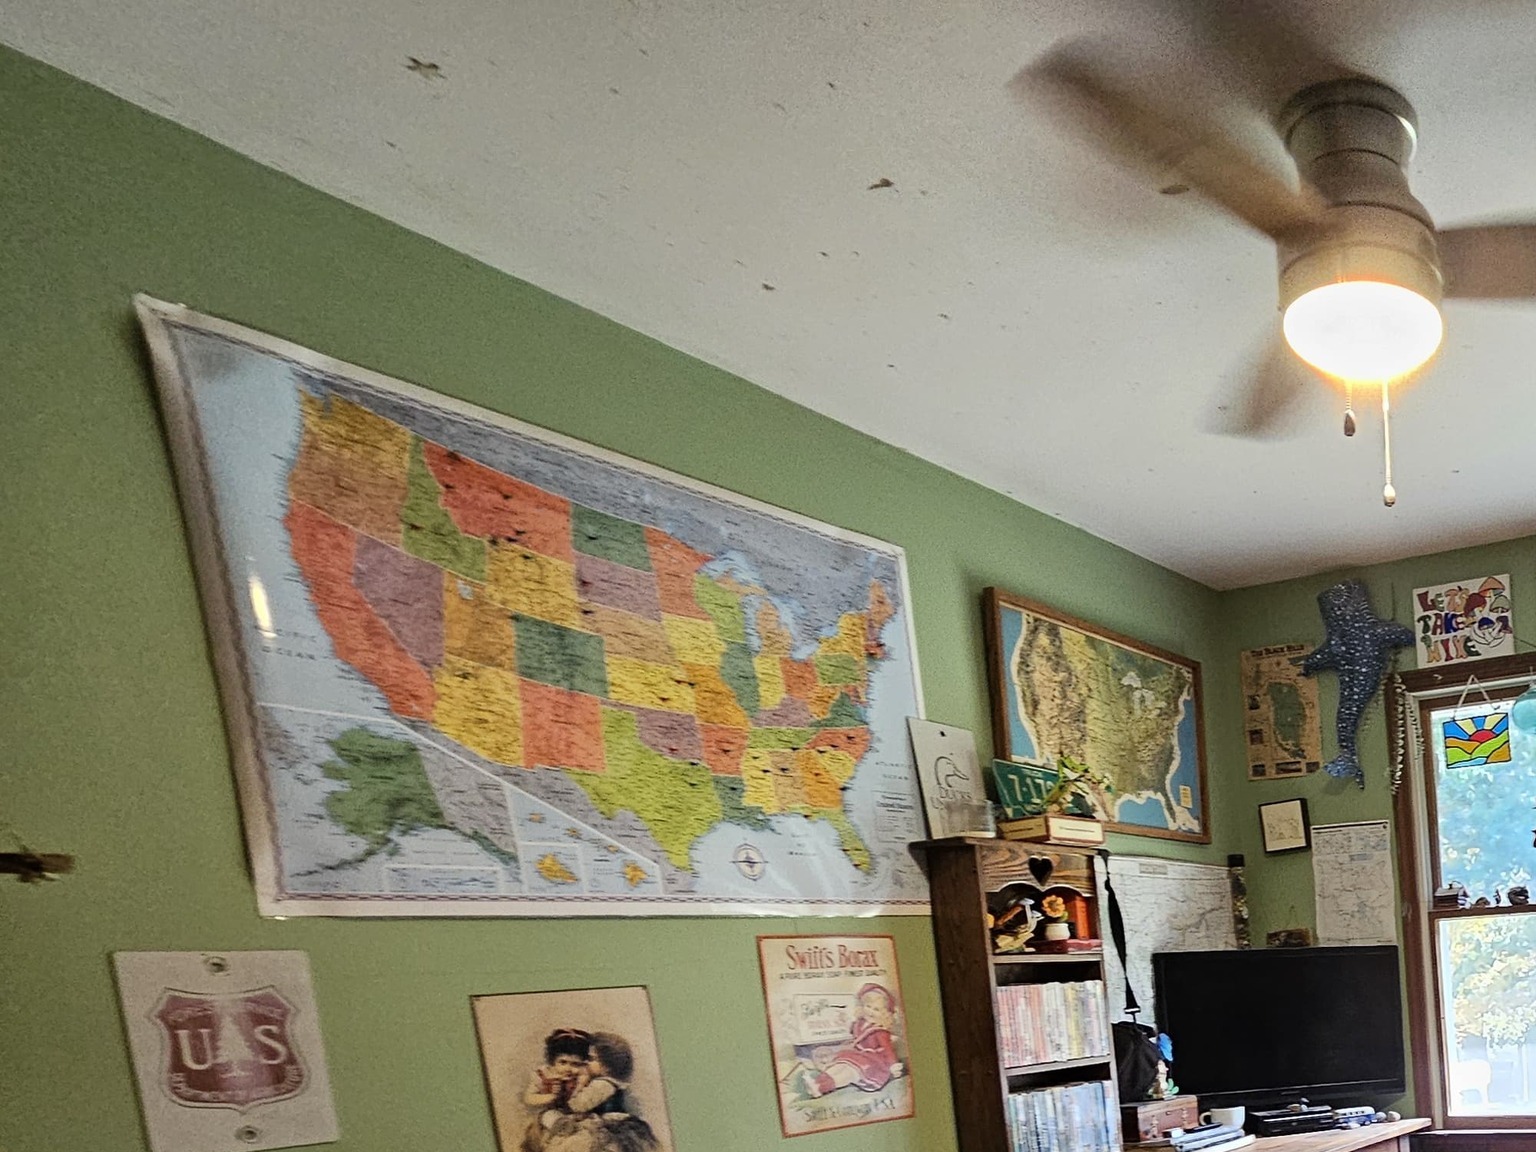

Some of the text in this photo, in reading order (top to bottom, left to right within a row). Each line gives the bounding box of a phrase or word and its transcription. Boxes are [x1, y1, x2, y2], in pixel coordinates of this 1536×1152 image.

[838, 945, 879, 968] Borax
[175, 1024, 287, 1070] U S
